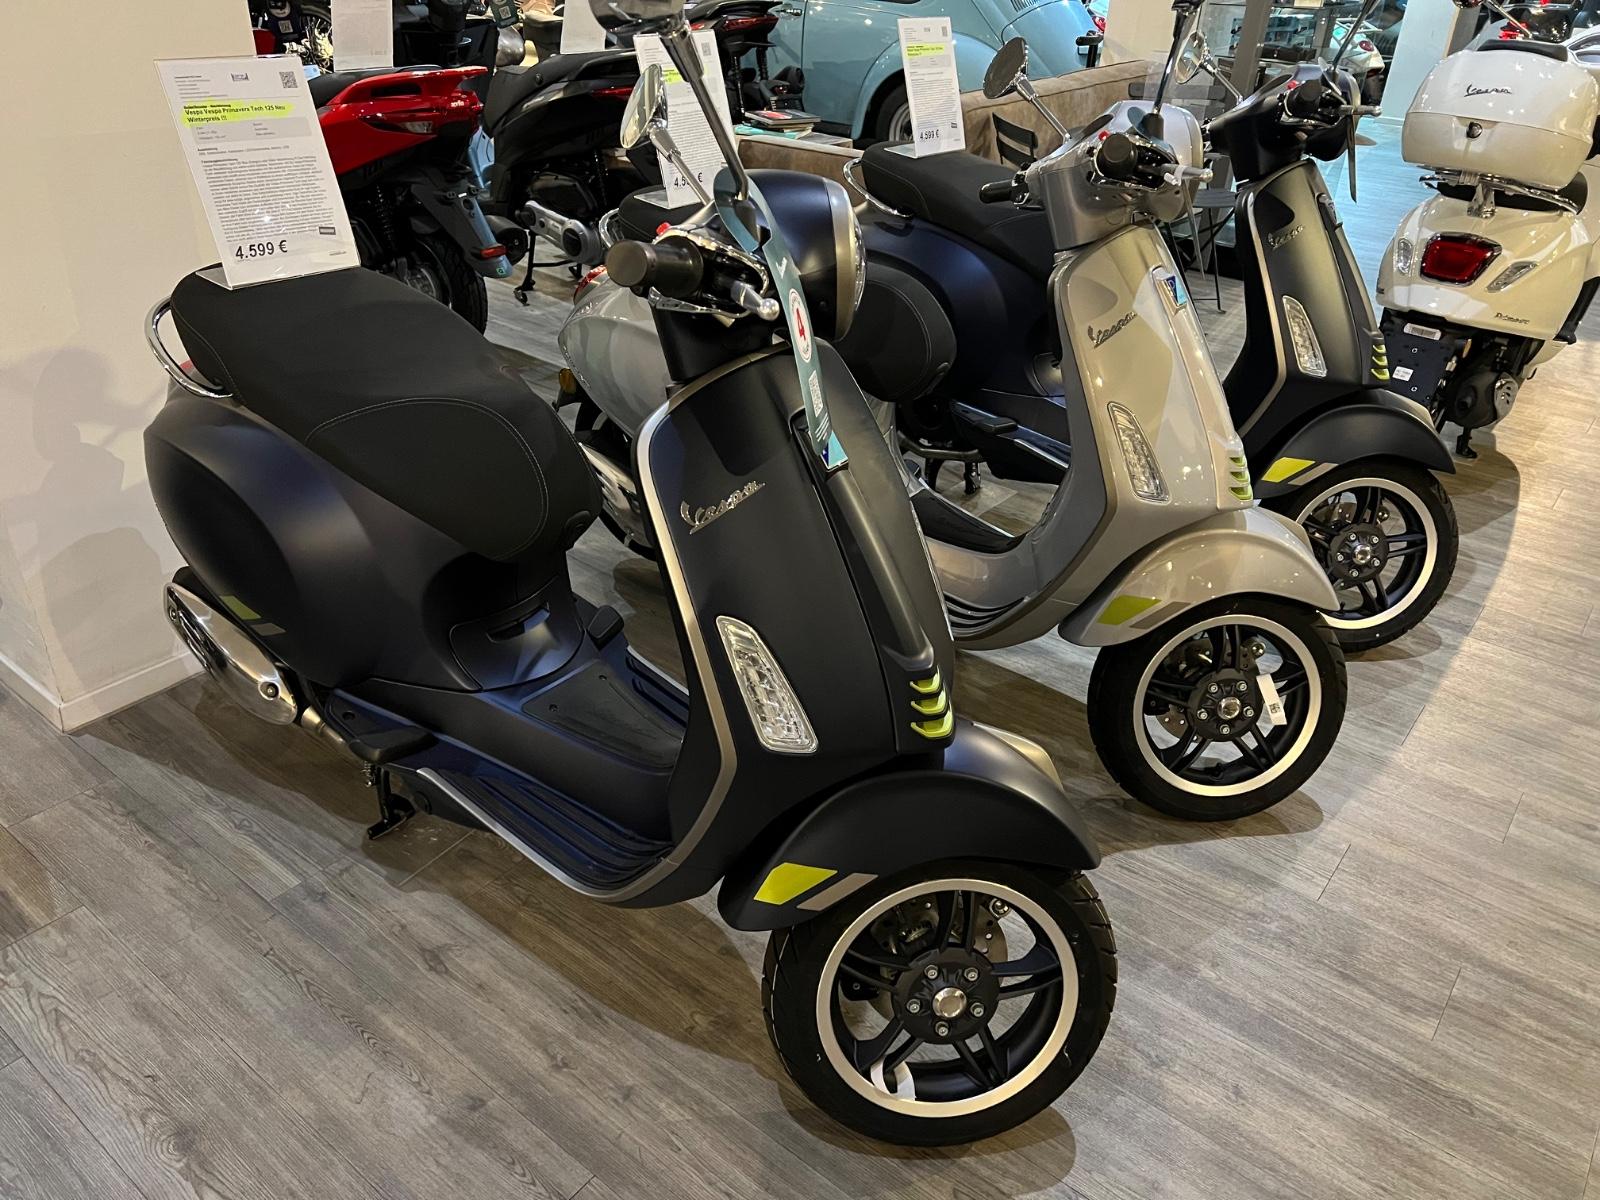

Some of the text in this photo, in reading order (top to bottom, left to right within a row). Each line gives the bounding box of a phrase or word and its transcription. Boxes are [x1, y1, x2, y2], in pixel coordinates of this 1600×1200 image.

[184, 108, 203, 116] Vespa
[204, 107, 222, 115] Vespa
[235, 240, 288, 259] 4.599 €
[680, 481, 766, 535] Vespa
